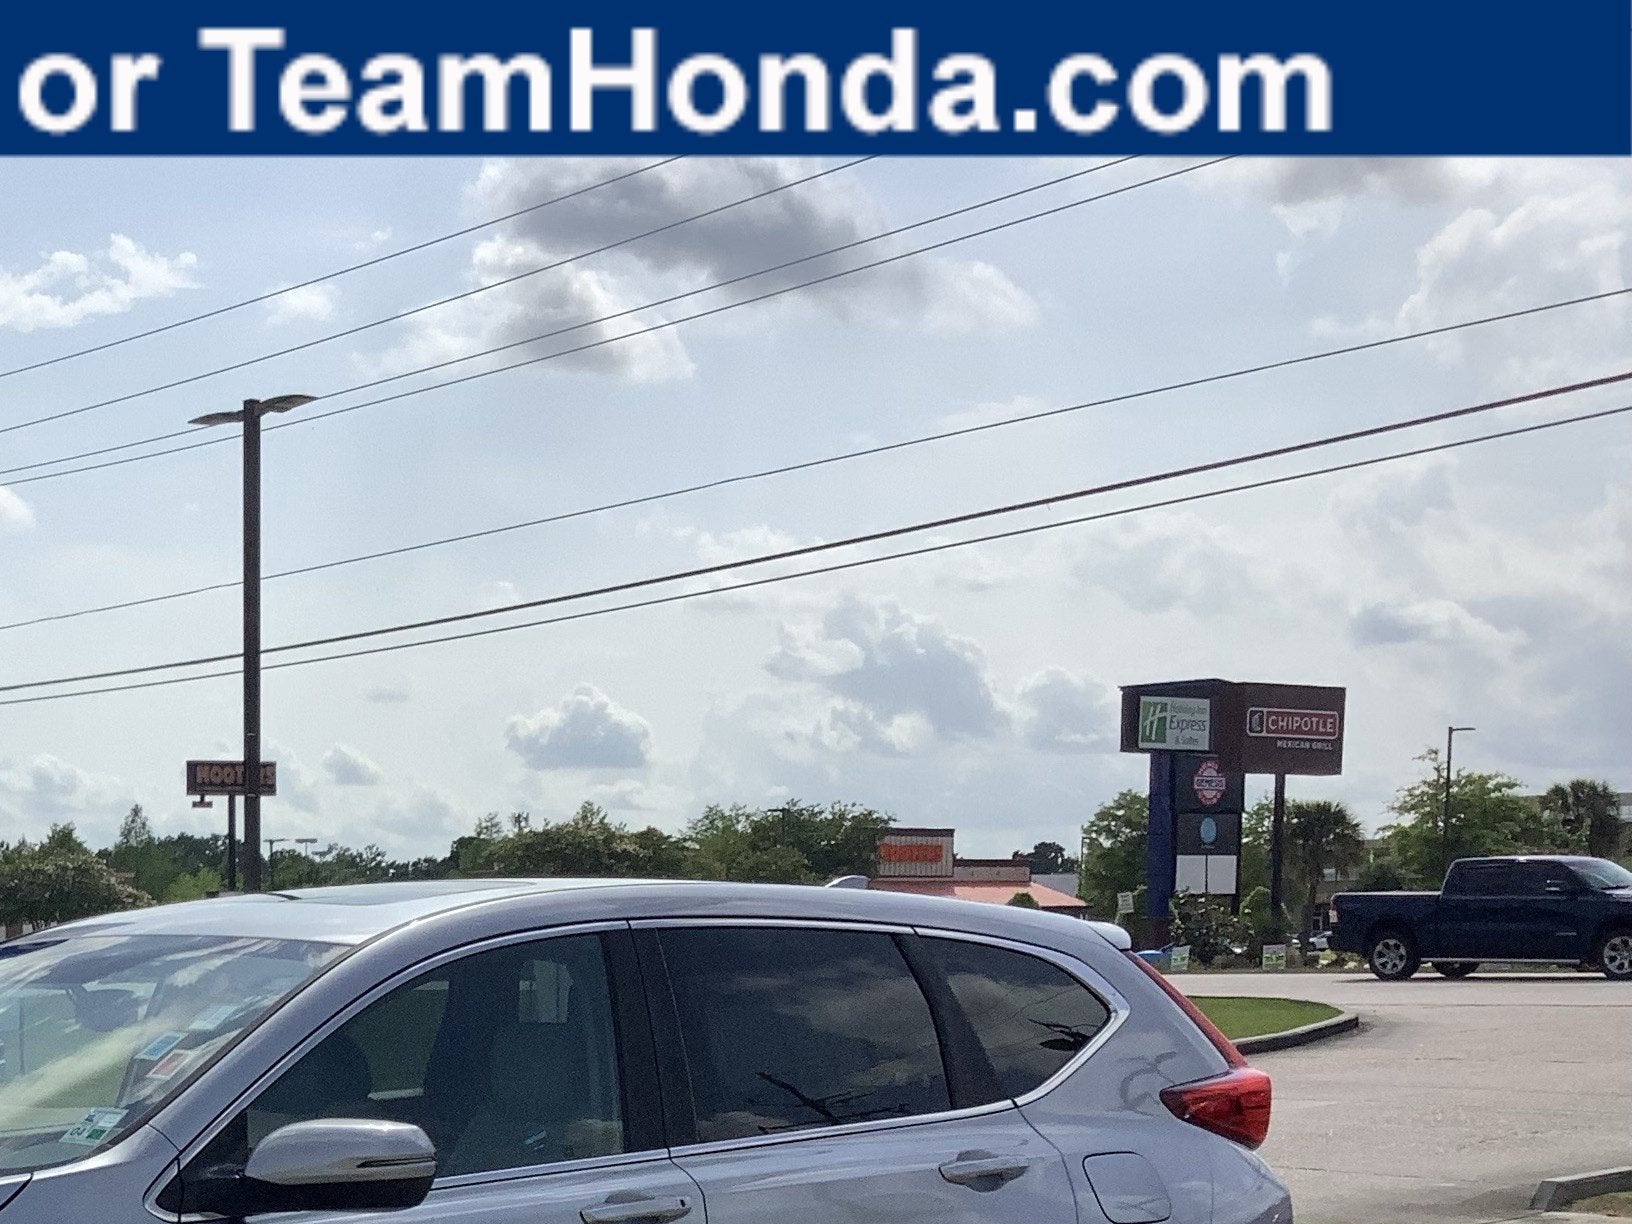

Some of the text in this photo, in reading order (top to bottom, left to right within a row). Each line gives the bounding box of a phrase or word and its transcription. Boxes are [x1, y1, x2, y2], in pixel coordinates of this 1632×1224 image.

[1169, 715, 1206, 732] Express
[1268, 715, 1334, 733] CHIPOTLE
[1276, 740, 1333, 751] MEXICAN GRILL
